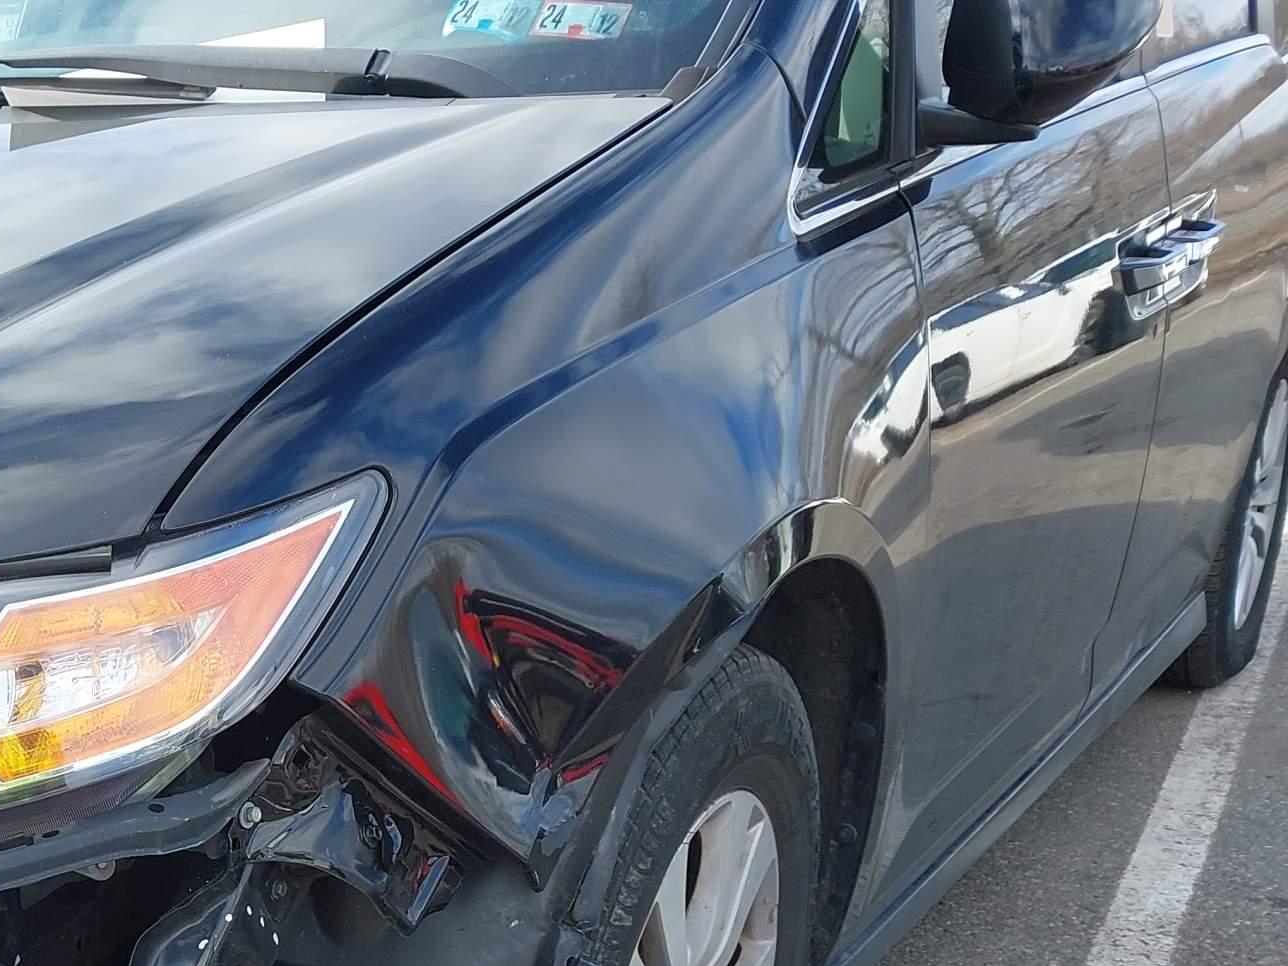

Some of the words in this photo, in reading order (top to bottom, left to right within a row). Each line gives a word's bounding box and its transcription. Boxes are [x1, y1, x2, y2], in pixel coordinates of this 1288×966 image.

[451, 0, 480, 24] 24
[539, 4, 569, 29] 24
[596, 13, 621, 35] 12
